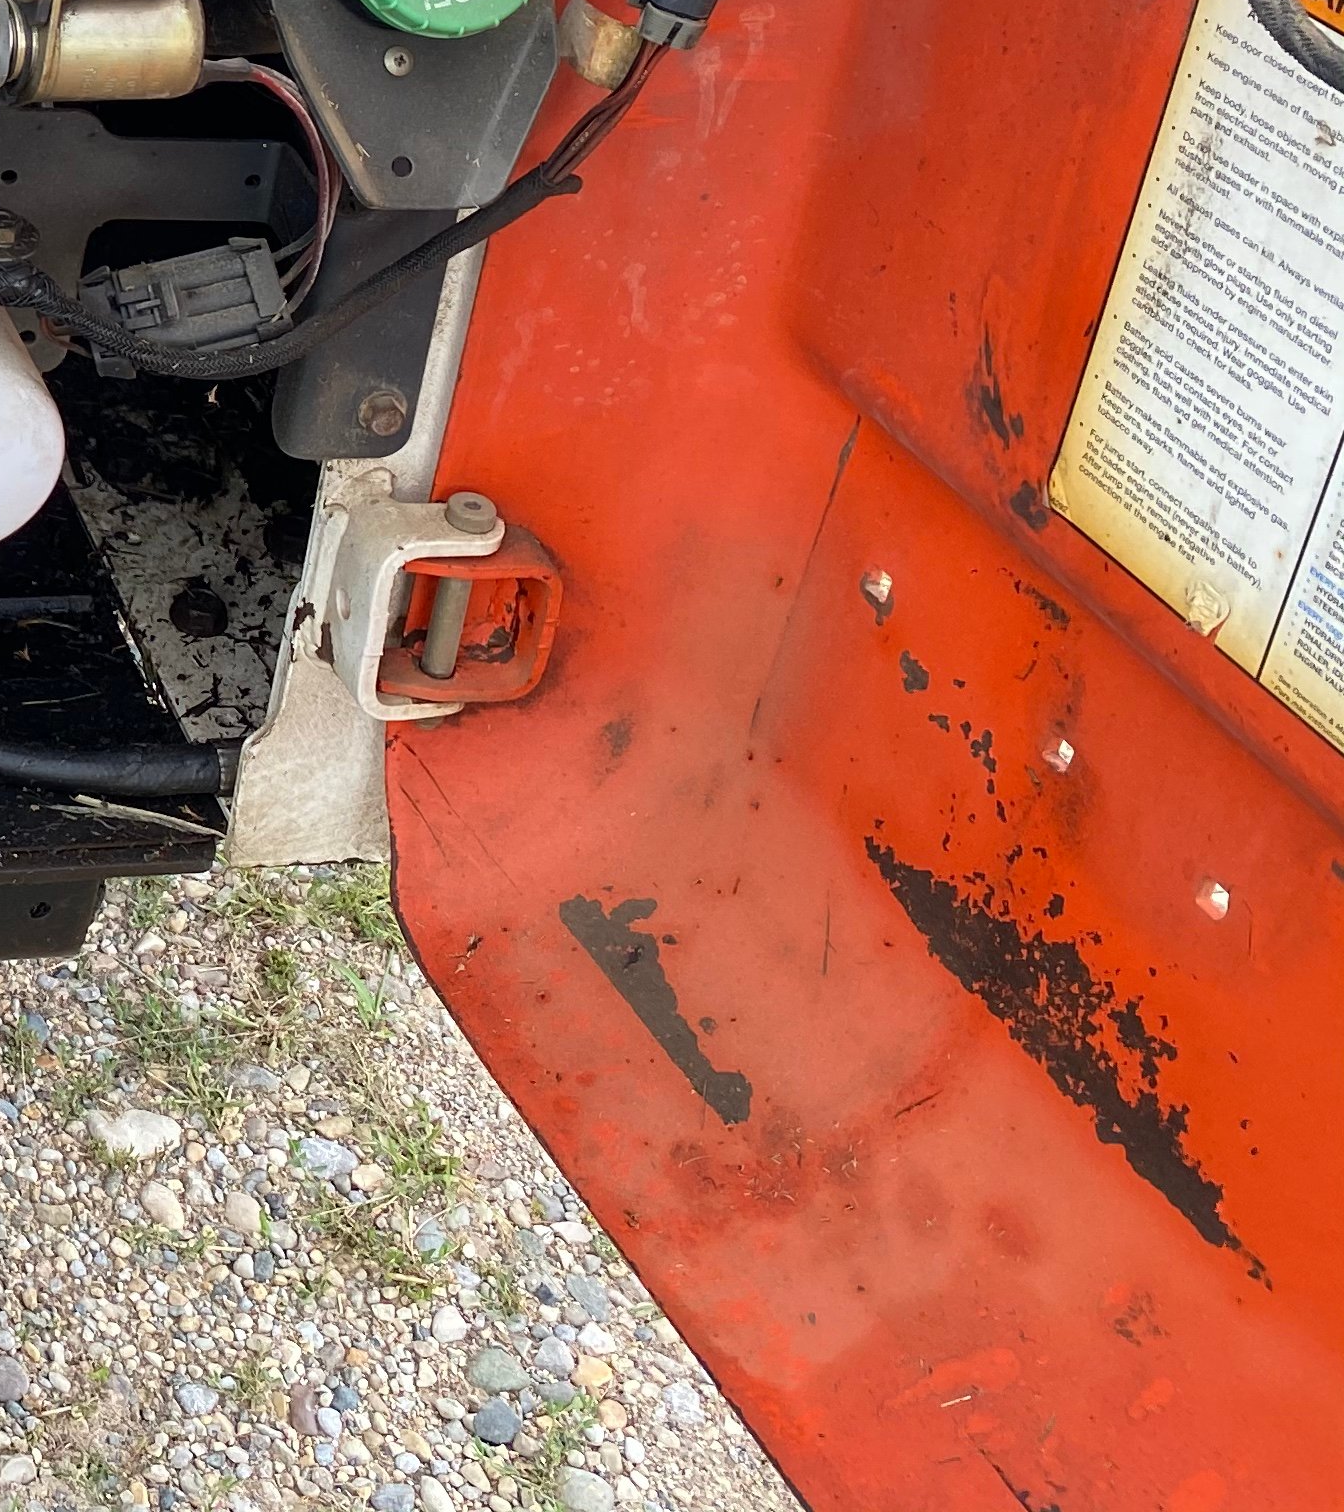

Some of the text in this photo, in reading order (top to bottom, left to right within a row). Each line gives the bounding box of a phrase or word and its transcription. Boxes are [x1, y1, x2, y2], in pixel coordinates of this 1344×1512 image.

[1206, 50, 1301, 115] Keep engine clean of
[1215, 23, 1344, 109] Keep door closed except for
[1194, 91, 1215, 110] from
[1216, 107, 1257, 137] electrical
[1302, 162, 1337, 190] moving
[1198, 77, 1221, 99] Keep
[1249, 110, 1275, 133] loose
[1276, 129, 1311, 156] objects
[1312, 152, 1332, 169] and
[1230, 162, 1321, 228] loader in space with
[1242, 187, 1324, 246] or with flammable
[1213, 217, 1310, 287] gases can Always
[1176, 281, 1333, 403] fluids under pressure can enter skin
[1203, 257, 1332, 354] glow Use only starting
[1223, 284, 1267, 321] by engine
[1225, 257, 1338, 340] or starting fluid on diesel
[1123, 320, 1287, 448] Battery acid causes wear
[1185, 337, 1212, 361] check
[1213, 355, 1227, 370] for
[1222, 345, 1246, 369] Wear
[1287, 393, 1306, 414] Use
[1104, 379, 1227, 481] Battery makes flammable and
[1112, 356, 1130, 375] with
[1130, 371, 1150, 390] eyes
[1151, 386, 1172, 407] flush
[1173, 404, 1191, 421] and
[1190, 418, 1206, 433] get
[1207, 431, 1242, 461] medical
[1152, 370, 1293, 486] flush well with For contact
[1155, 358, 1163, 370] If
[1163, 367, 1182, 385] acid
[1183, 382, 1220, 414] contacts
[1267, 446, 1278, 457] or
[1292, 385, 1331, 416] medical
[1081, 451, 1178, 534] After remove
[1086, 440, 1225, 558] the loader engine last (never at the
[1100, 391, 1122, 414] Keep
[1176, 452, 1205, 480] flames
[1206, 477, 1224, 494] and
[1224, 489, 1256, 519] lighted
[1148, 478, 1257, 569] connect negative cable to
